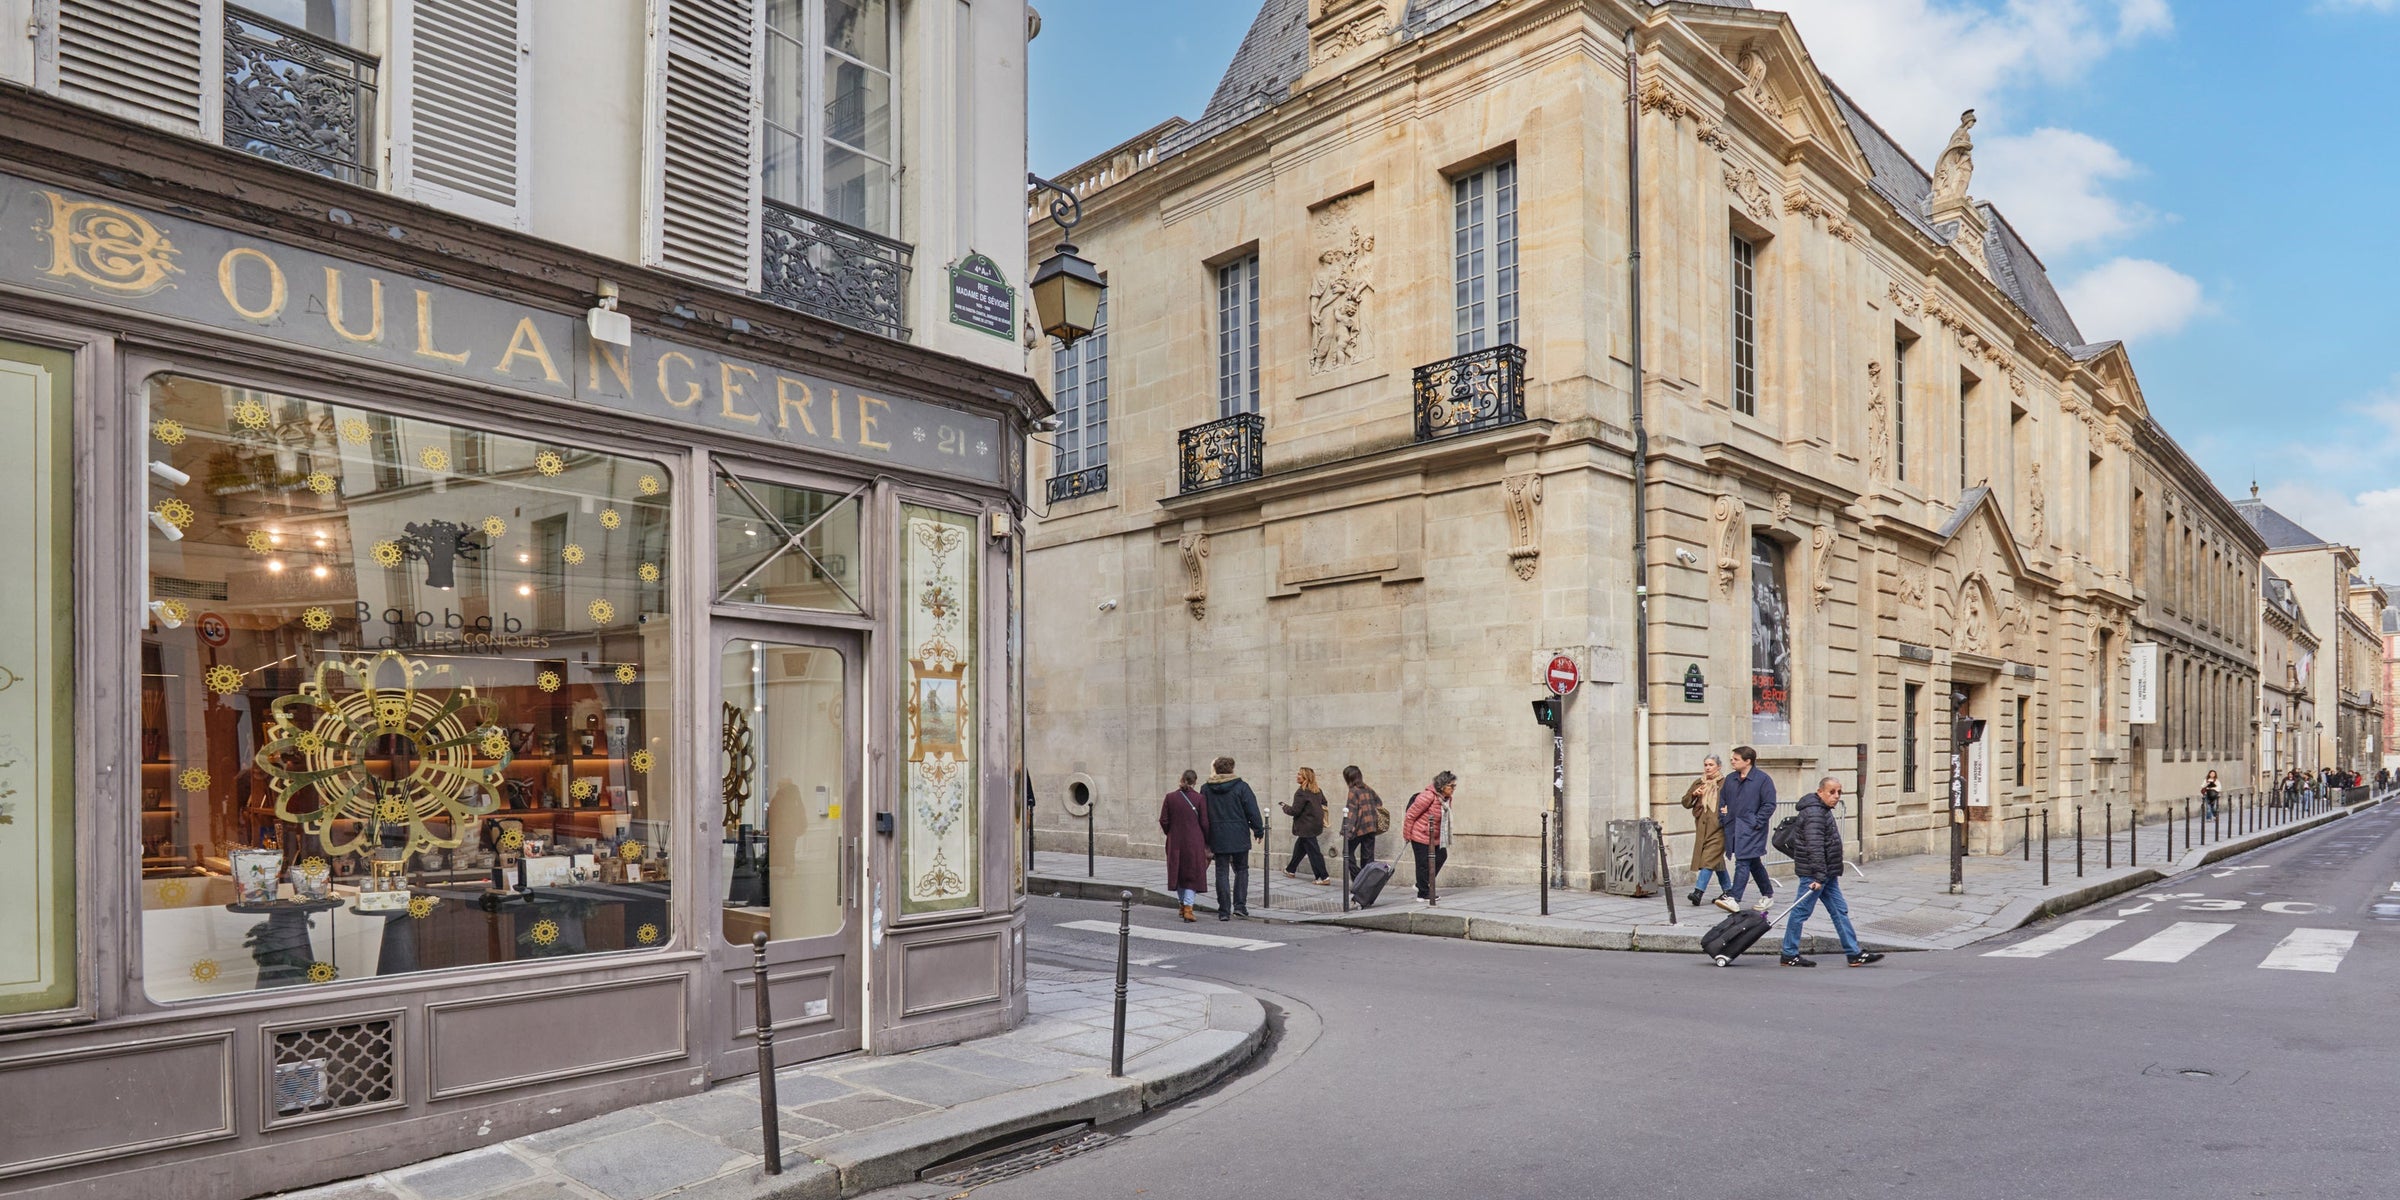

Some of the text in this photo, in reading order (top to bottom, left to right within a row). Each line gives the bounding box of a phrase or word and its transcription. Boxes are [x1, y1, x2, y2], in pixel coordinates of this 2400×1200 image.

[956, 286, 979, 300] MADAME
[980, 293, 987, 303] DE
[987, 295, 1010, 310] SÉVIGNÉ
[978, 283, 989, 293] RUE
[28, 189, 966, 456] BOULANGERIE 21
[355, 600, 522, 634] Baobab
[424, 630, 550, 649] LES ICONIQUES
